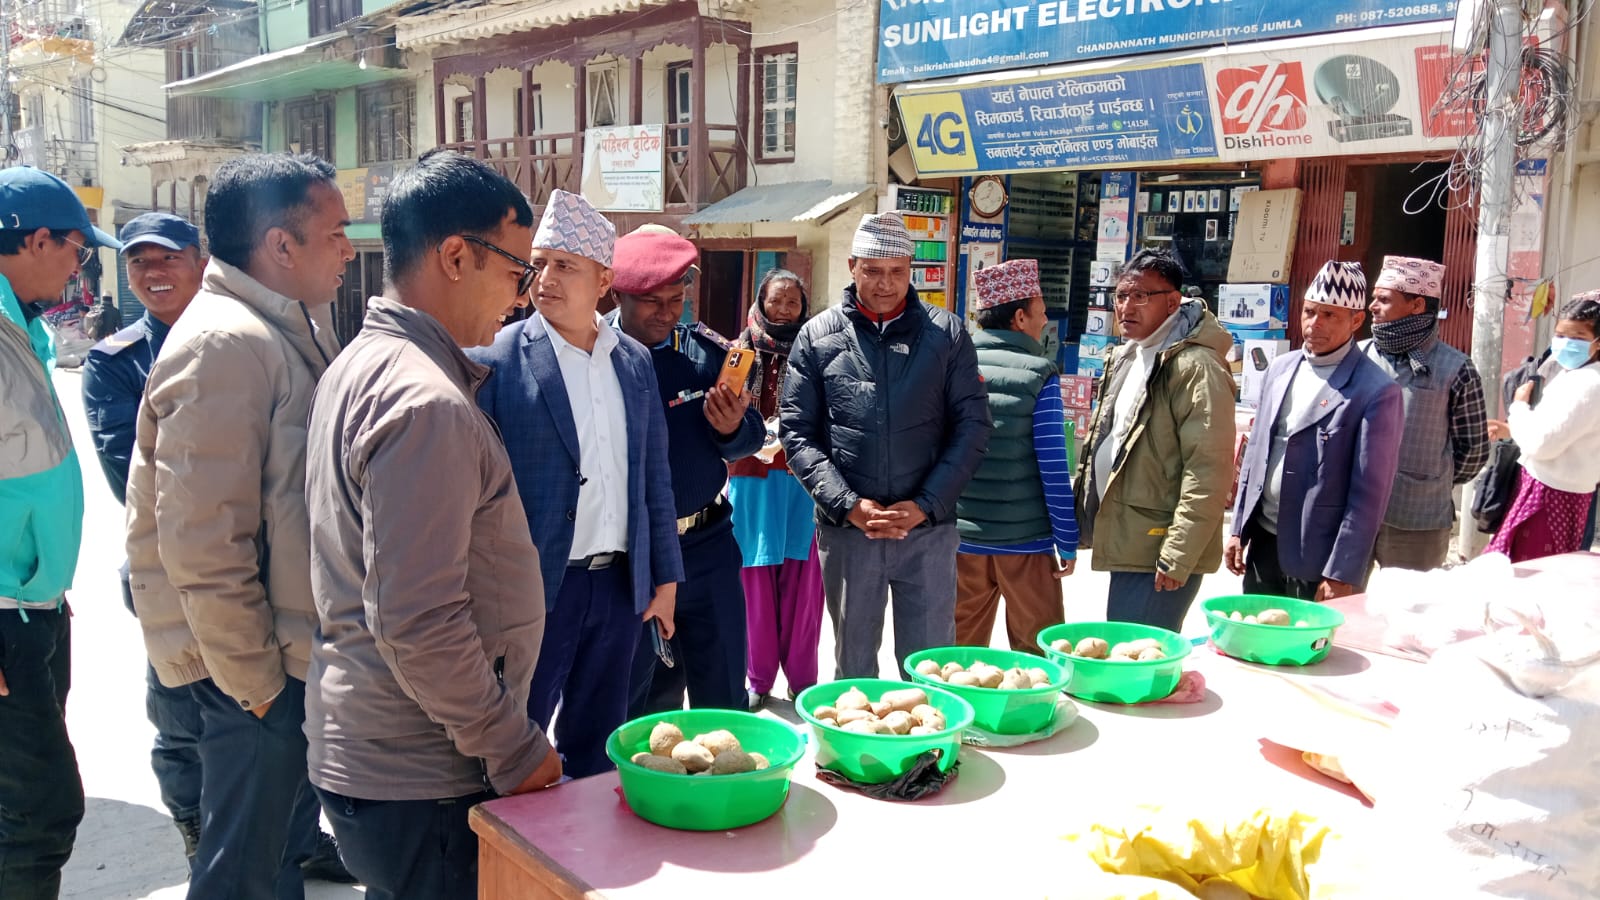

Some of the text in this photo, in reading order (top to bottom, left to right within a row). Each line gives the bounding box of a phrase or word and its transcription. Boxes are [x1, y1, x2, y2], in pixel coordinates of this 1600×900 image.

[883, 5, 1030, 48] SUNLIGHT
[1335, 13, 1357, 25] PH:
[1360, 3, 1441, 21] 087-520688,
[1076, 19, 1303, 54] CHANDANNATH MUNICIPALITY-05 JUMLA
[882, 66, 905, 77] Email
[1017, 85, 1054, 101] नेपाल
[1057, 74, 1127, 97] टेलिकमको
[1099, 97, 1145, 116] पाईन्छ
[916, 110, 967, 156] 4G
[985, 142, 1027, 159] सनलाईट
[1091, 139, 1114, 152] एण्ड
[1116, 133, 1159, 151] मोबाईल
[1223, 133, 1313, 150] DishHome
[1261, 199, 1272, 229] Xiaomi
